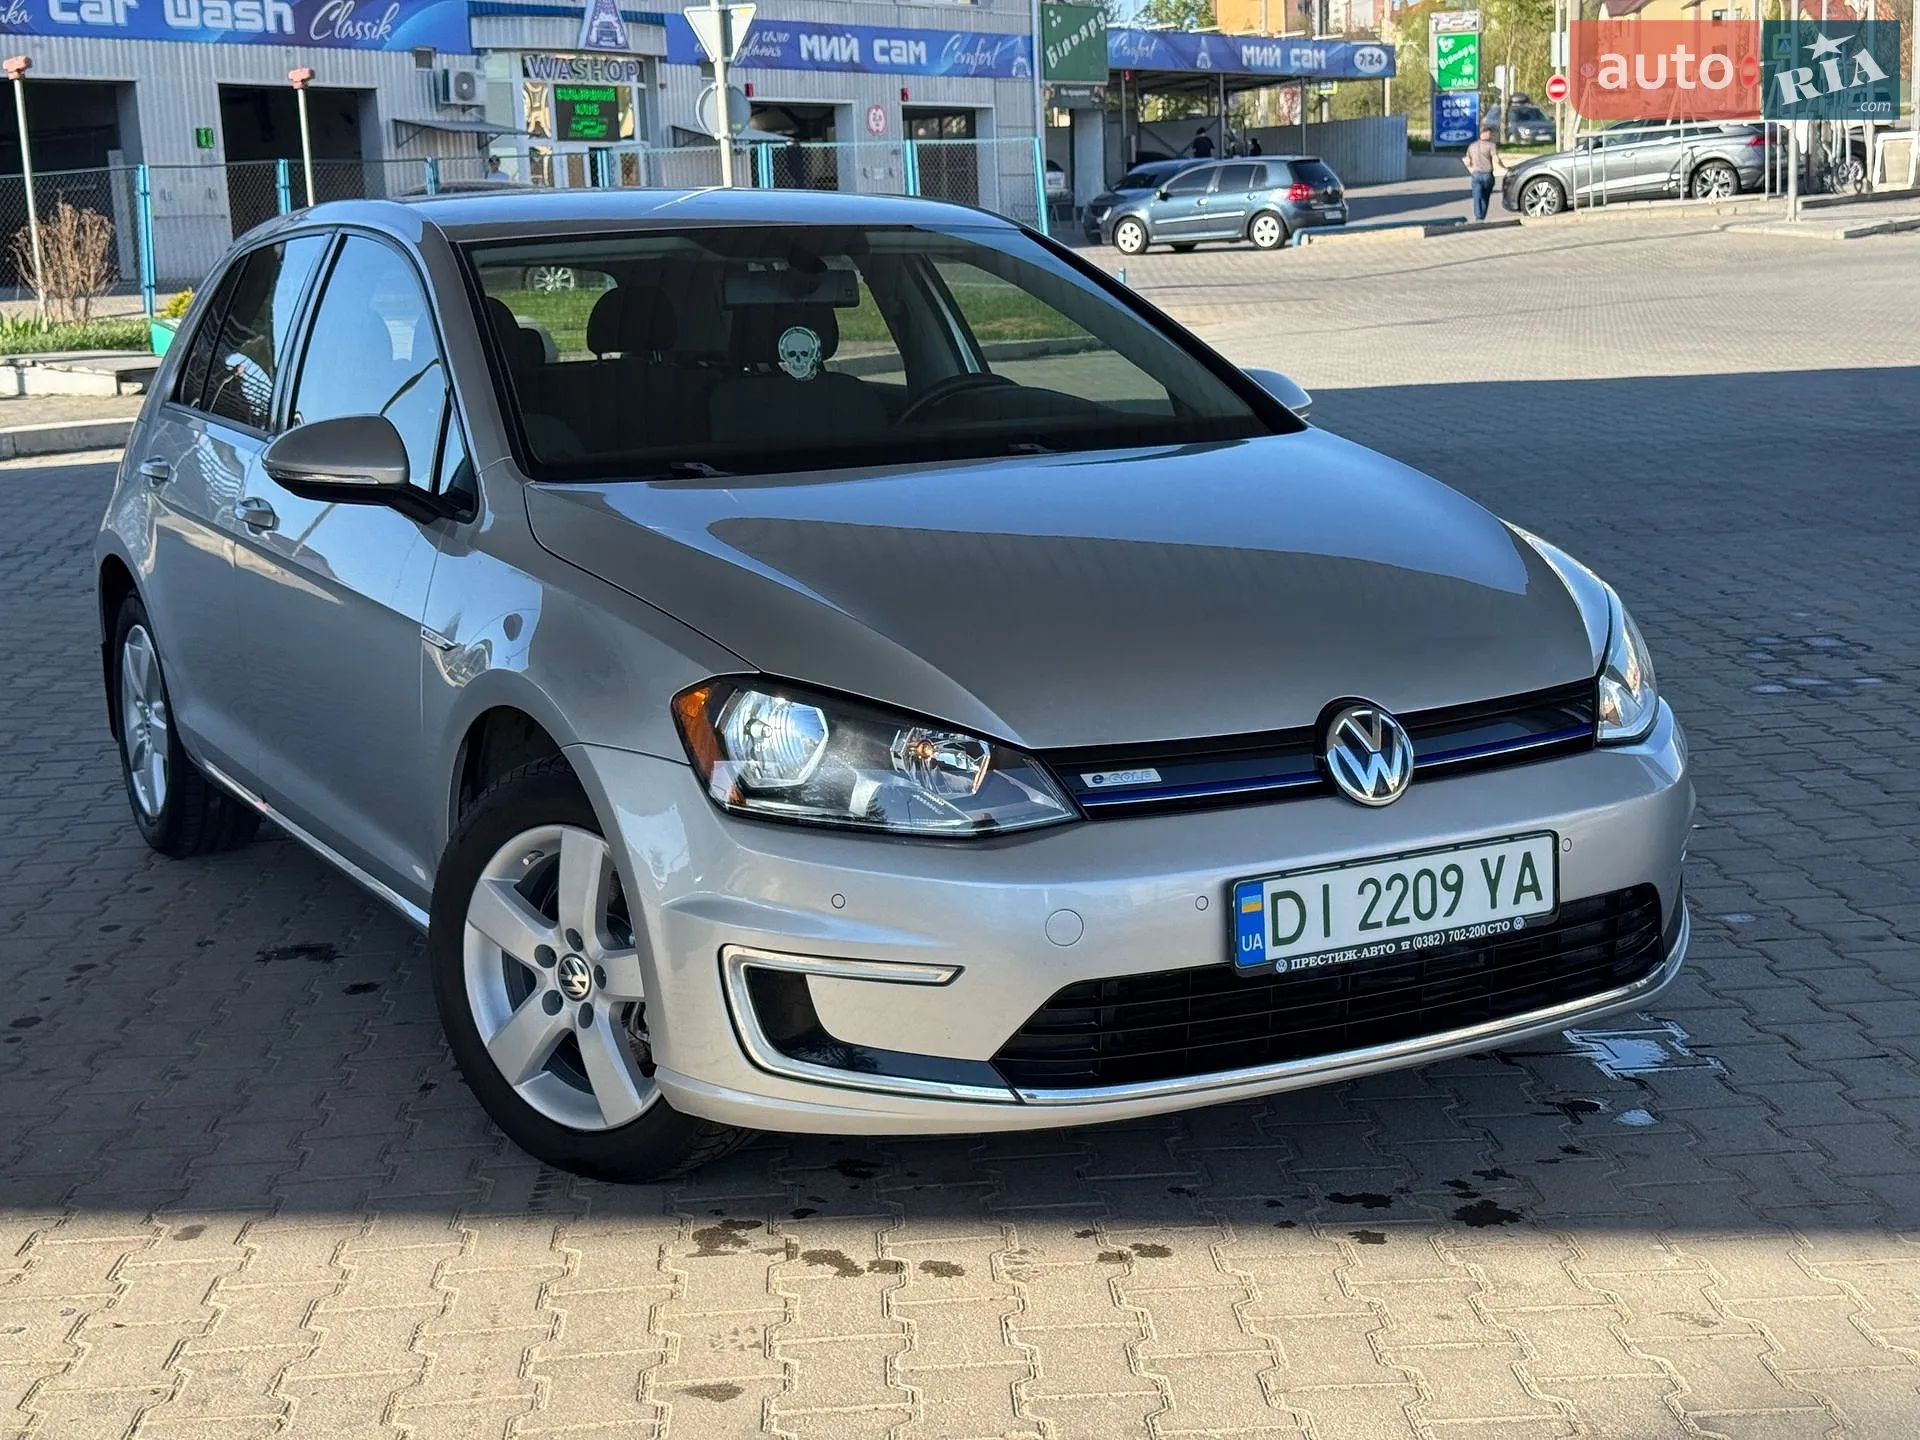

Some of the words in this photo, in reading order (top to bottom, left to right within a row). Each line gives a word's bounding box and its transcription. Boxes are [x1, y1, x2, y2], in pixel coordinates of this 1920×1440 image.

[523, 55, 640, 81] WASHOP
[940, 32, 1006, 75] Comfort
[1271, 884, 1331, 947] DI
[1357, 863, 1465, 932] 2209
[1480, 851, 1544, 910] YA
[1241, 933, 1263, 952] UA
[1290, 943, 1396, 970] ПРЕСТИЖ-АВТО
[1412, 932, 1446, 950] (0382)
[1448, 925, 1487, 942] 702-200
[1487, 920, 1511, 934] СТО
